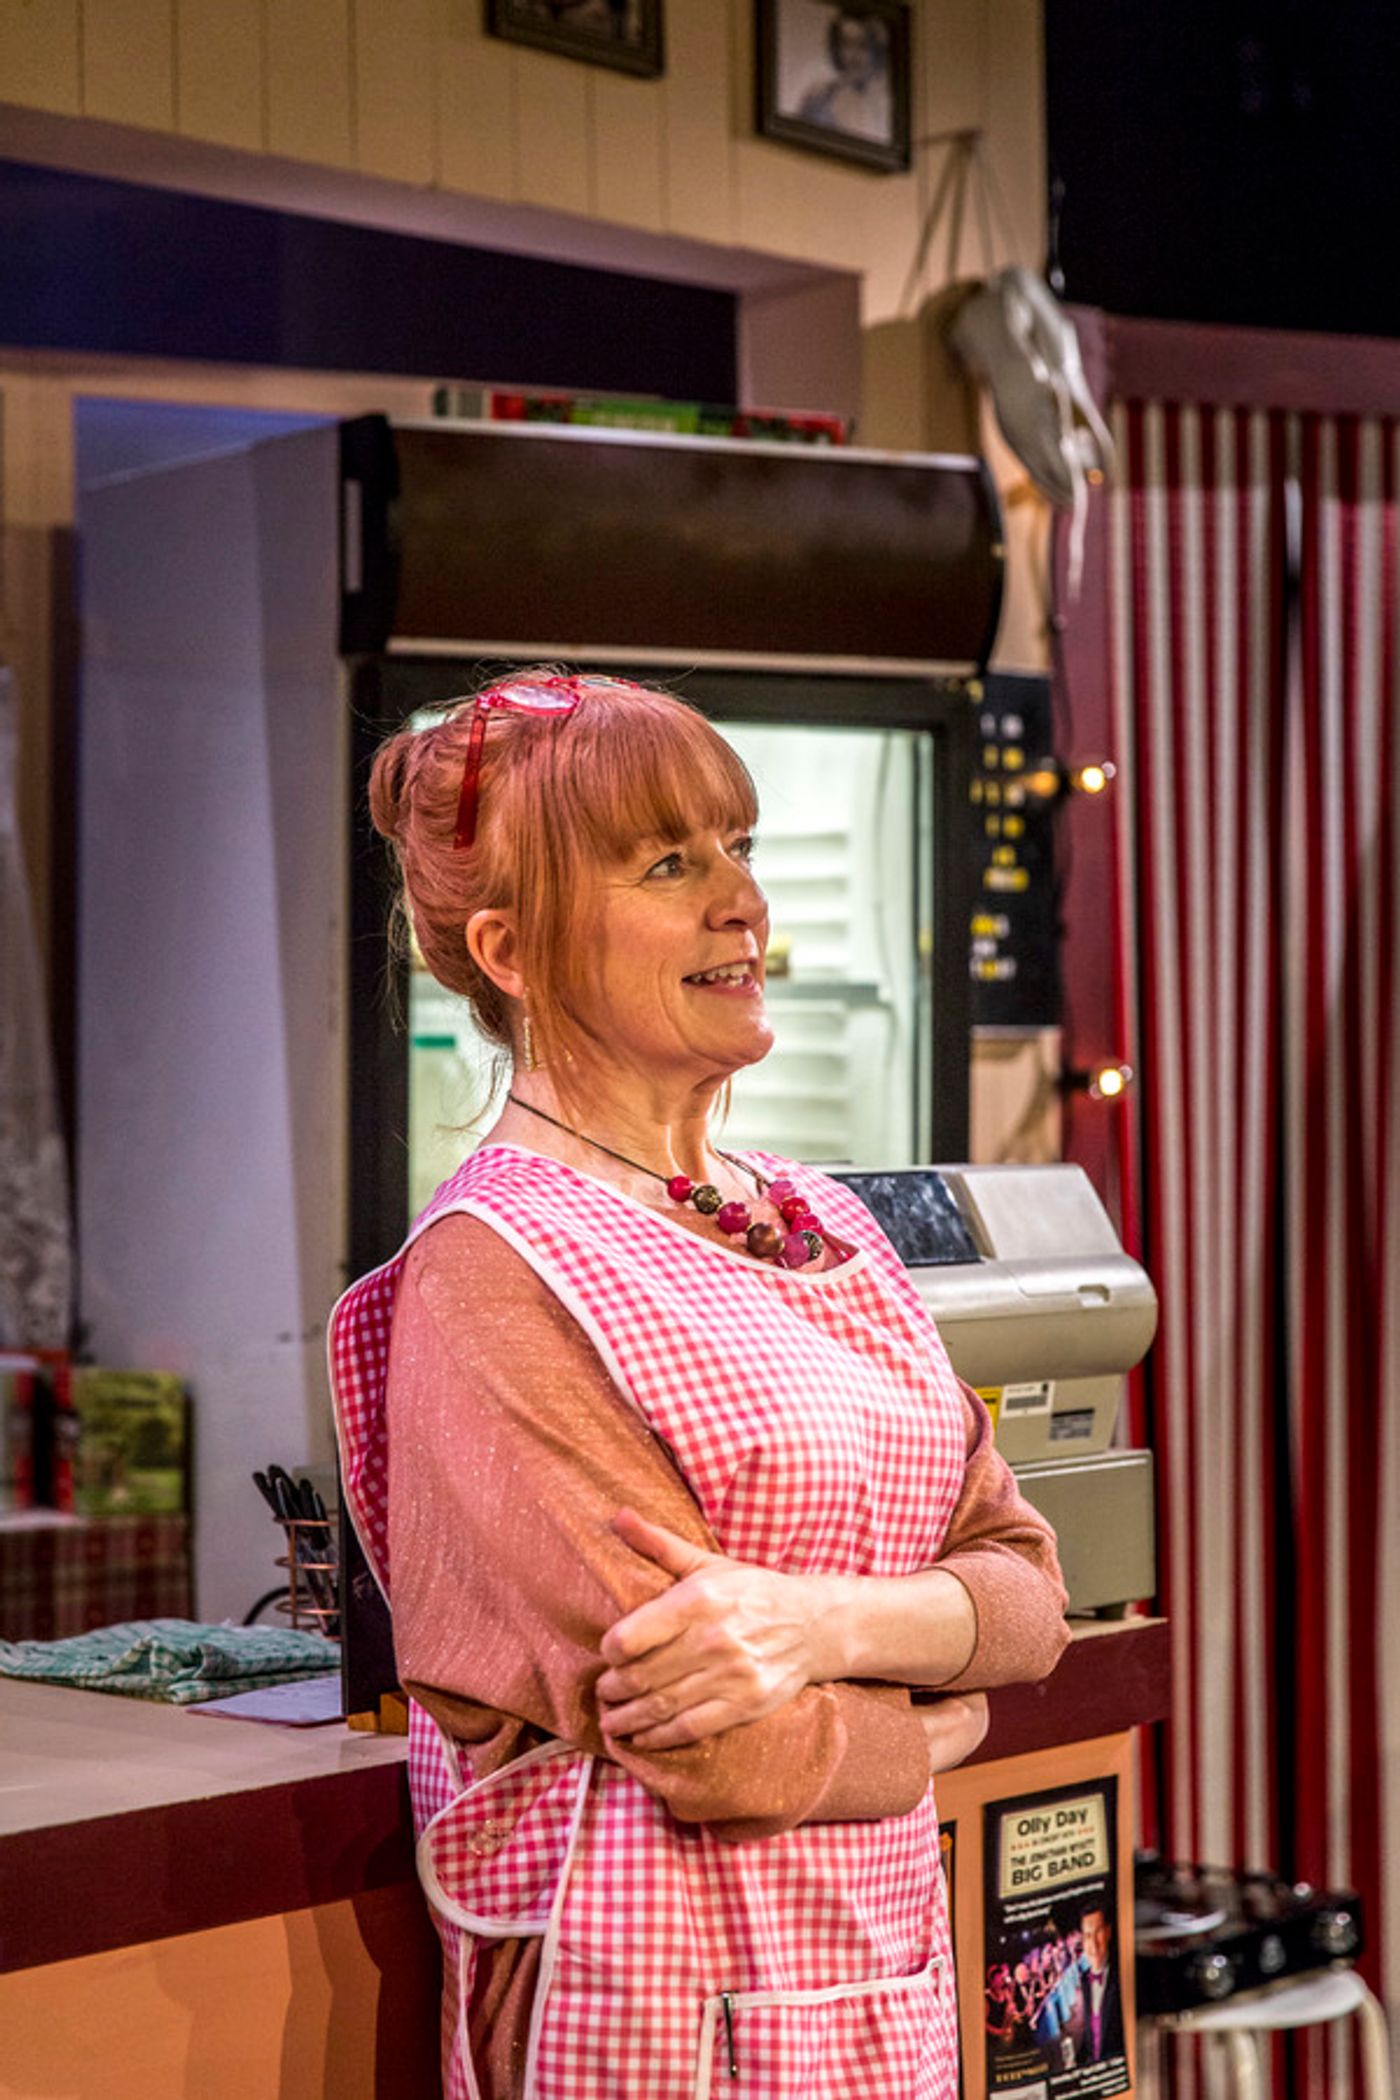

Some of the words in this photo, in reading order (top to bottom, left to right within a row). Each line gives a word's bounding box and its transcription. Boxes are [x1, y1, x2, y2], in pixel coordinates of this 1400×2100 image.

[1017, 1817, 1050, 1836] Olly
[1056, 1807, 1088, 1828] Day
[1012, 1865, 1042, 1886] BIG
[1048, 1852, 1095, 1877] BAND
